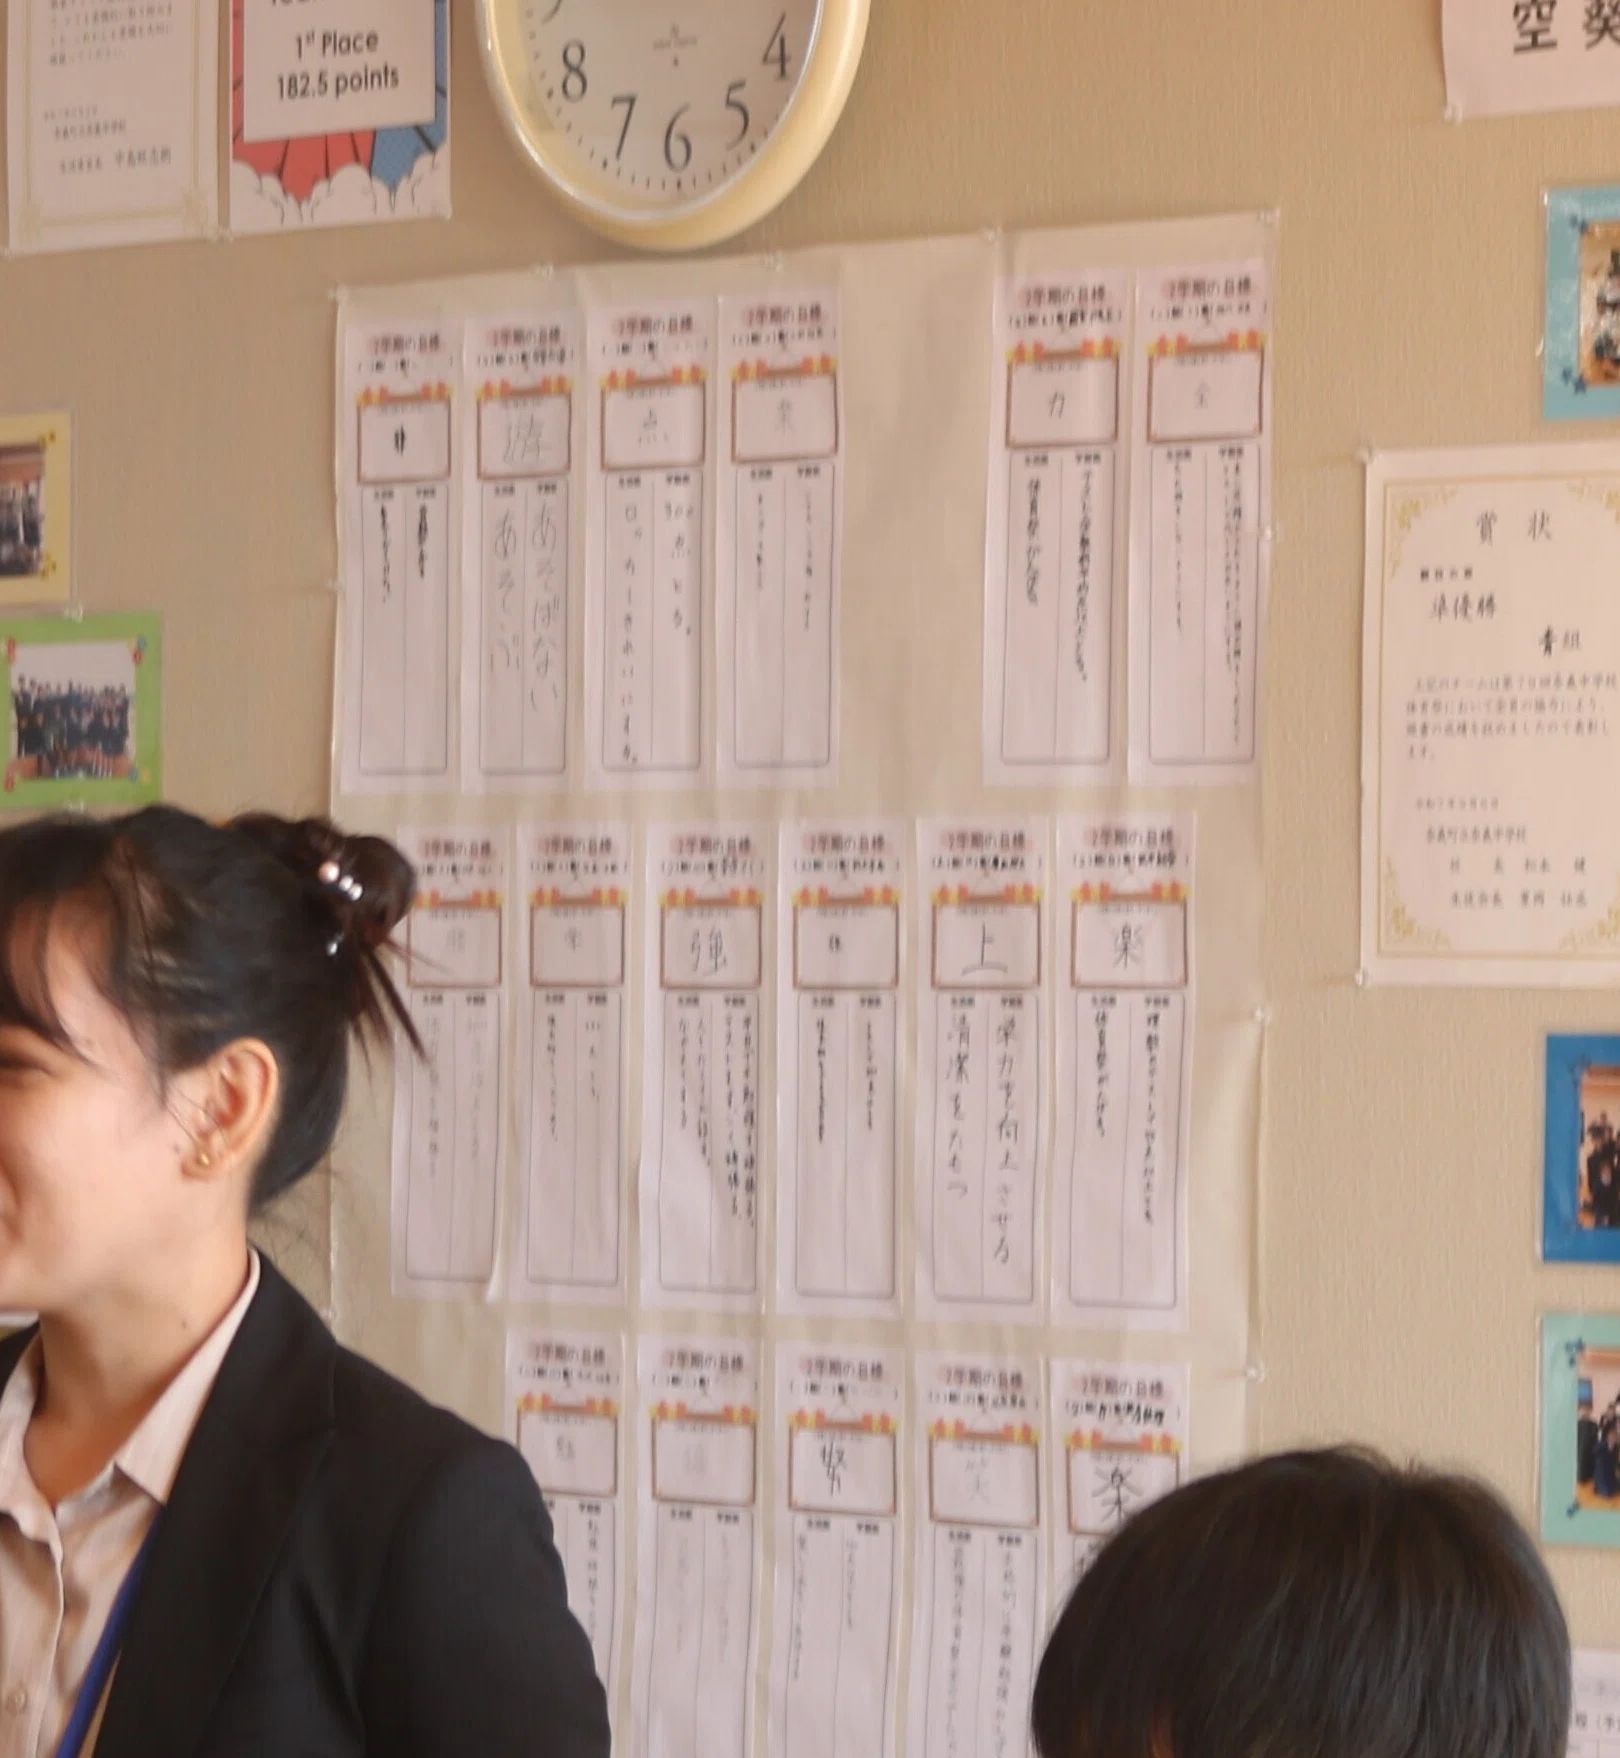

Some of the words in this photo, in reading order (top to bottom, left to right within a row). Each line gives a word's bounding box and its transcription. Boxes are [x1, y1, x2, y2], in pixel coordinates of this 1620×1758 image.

[321, 29, 379, 54] Place
[562, 40, 588, 101] 8
[762, 12, 792, 82] 4
[278, 75, 330, 101] 182.5
[335, 64, 400, 99] points
[611, 95, 637, 161] 7
[664, 103, 691, 172] 6
[725, 79, 751, 150] 5
[1476, 509, 1552, 546] 賞状
